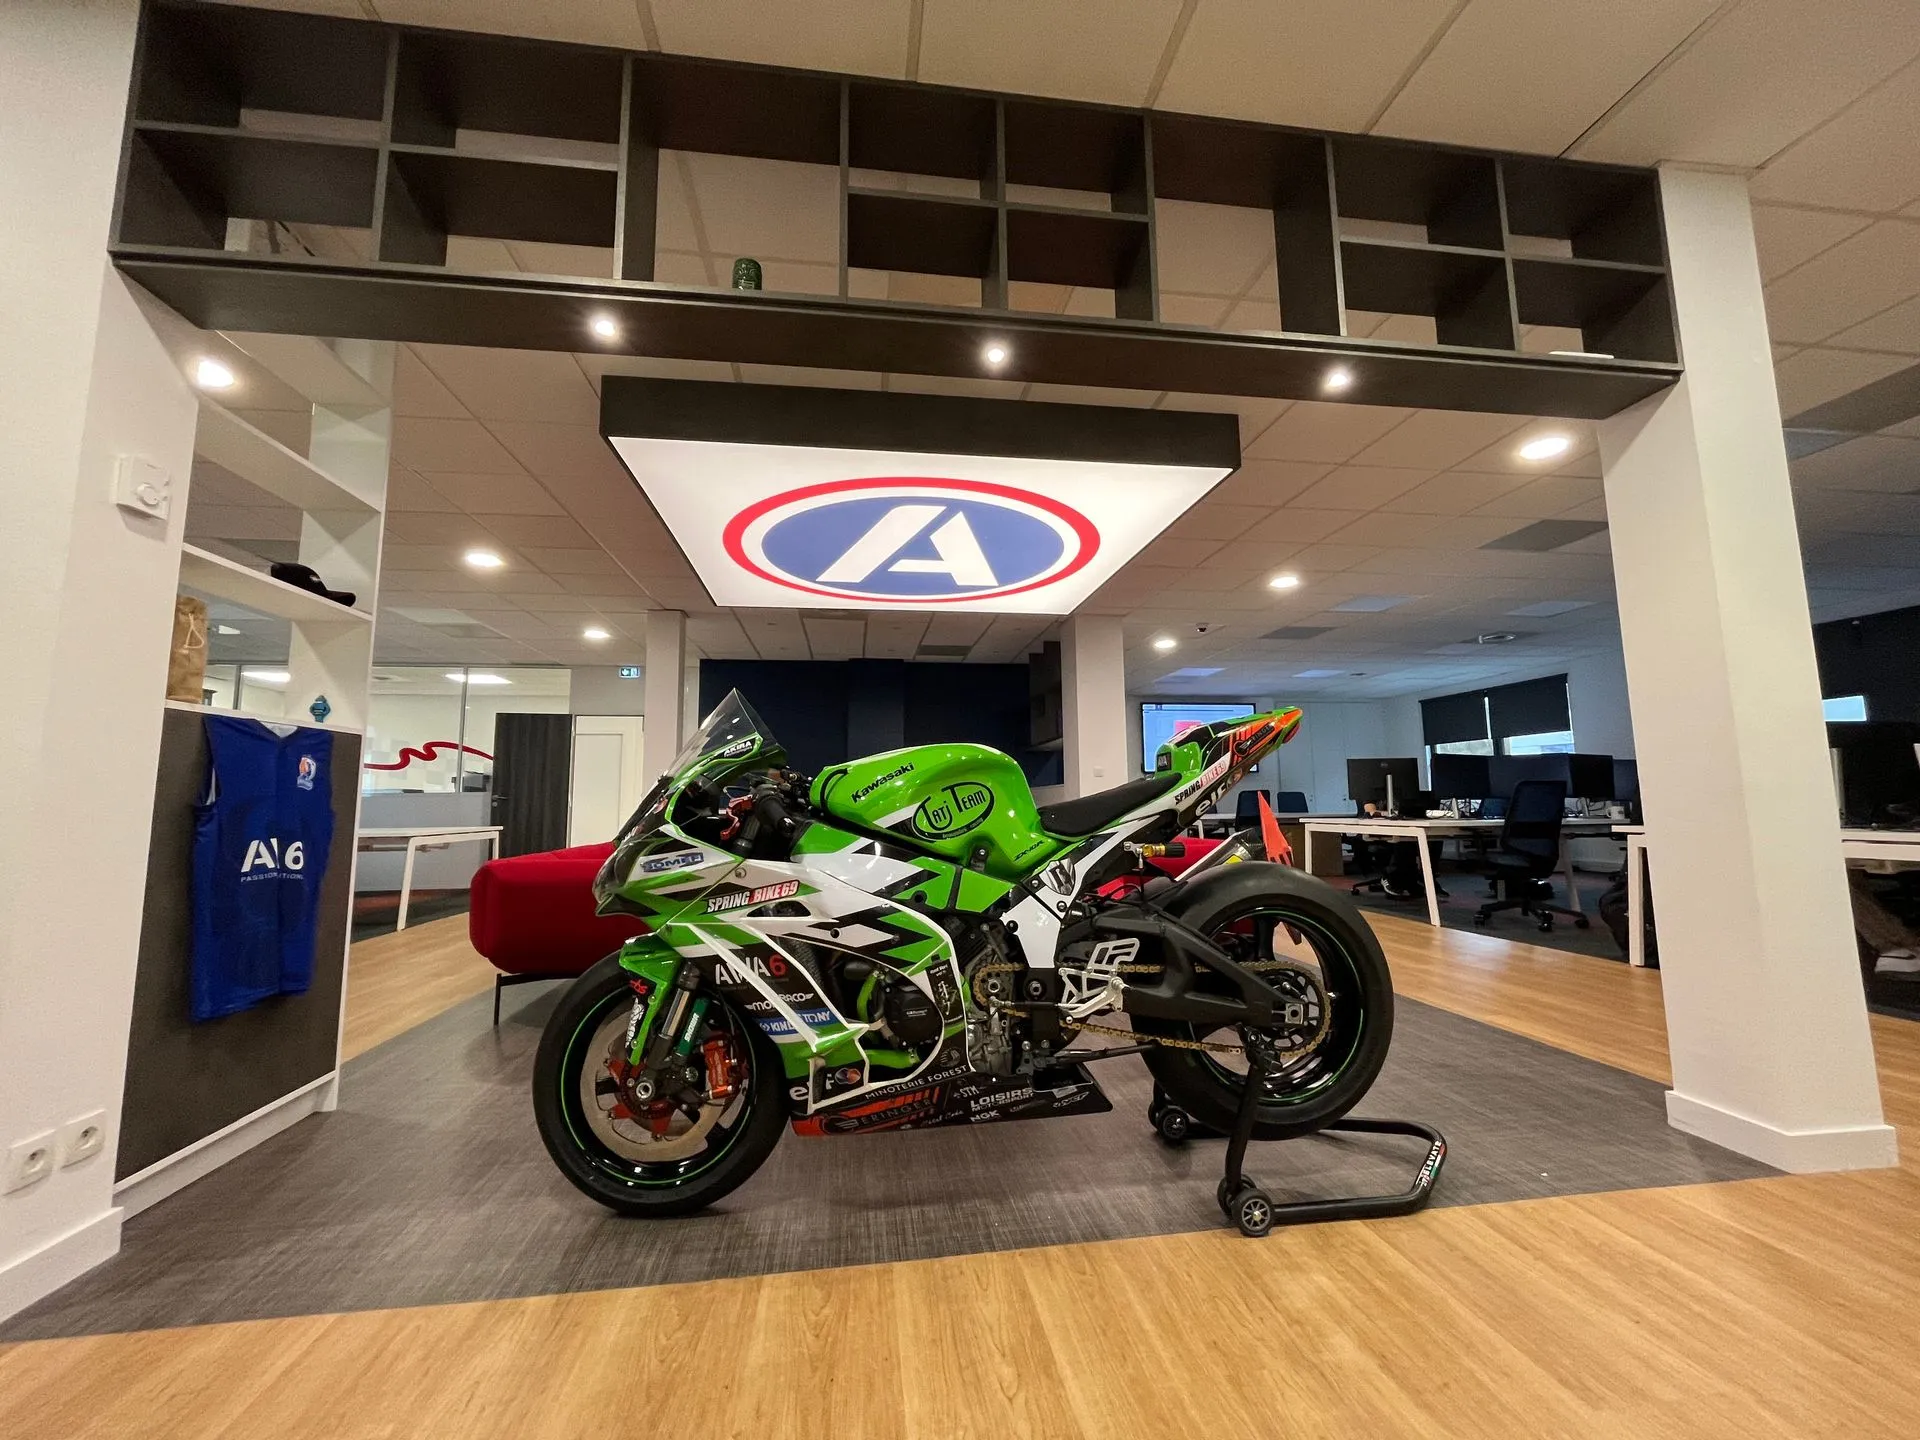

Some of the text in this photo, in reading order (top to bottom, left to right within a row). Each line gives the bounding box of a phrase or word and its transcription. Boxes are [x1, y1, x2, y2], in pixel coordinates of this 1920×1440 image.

[723, 740, 752, 758] AKIRA
[851, 761, 915, 803] Kawasaki
[1174, 780, 1201, 806] SPRING
[708, 880, 799, 914] SPRING BIKE69
[865, 1064, 967, 1100] MINOTERIE FOREST
[970, 1087, 1033, 1109] LOISIRS
